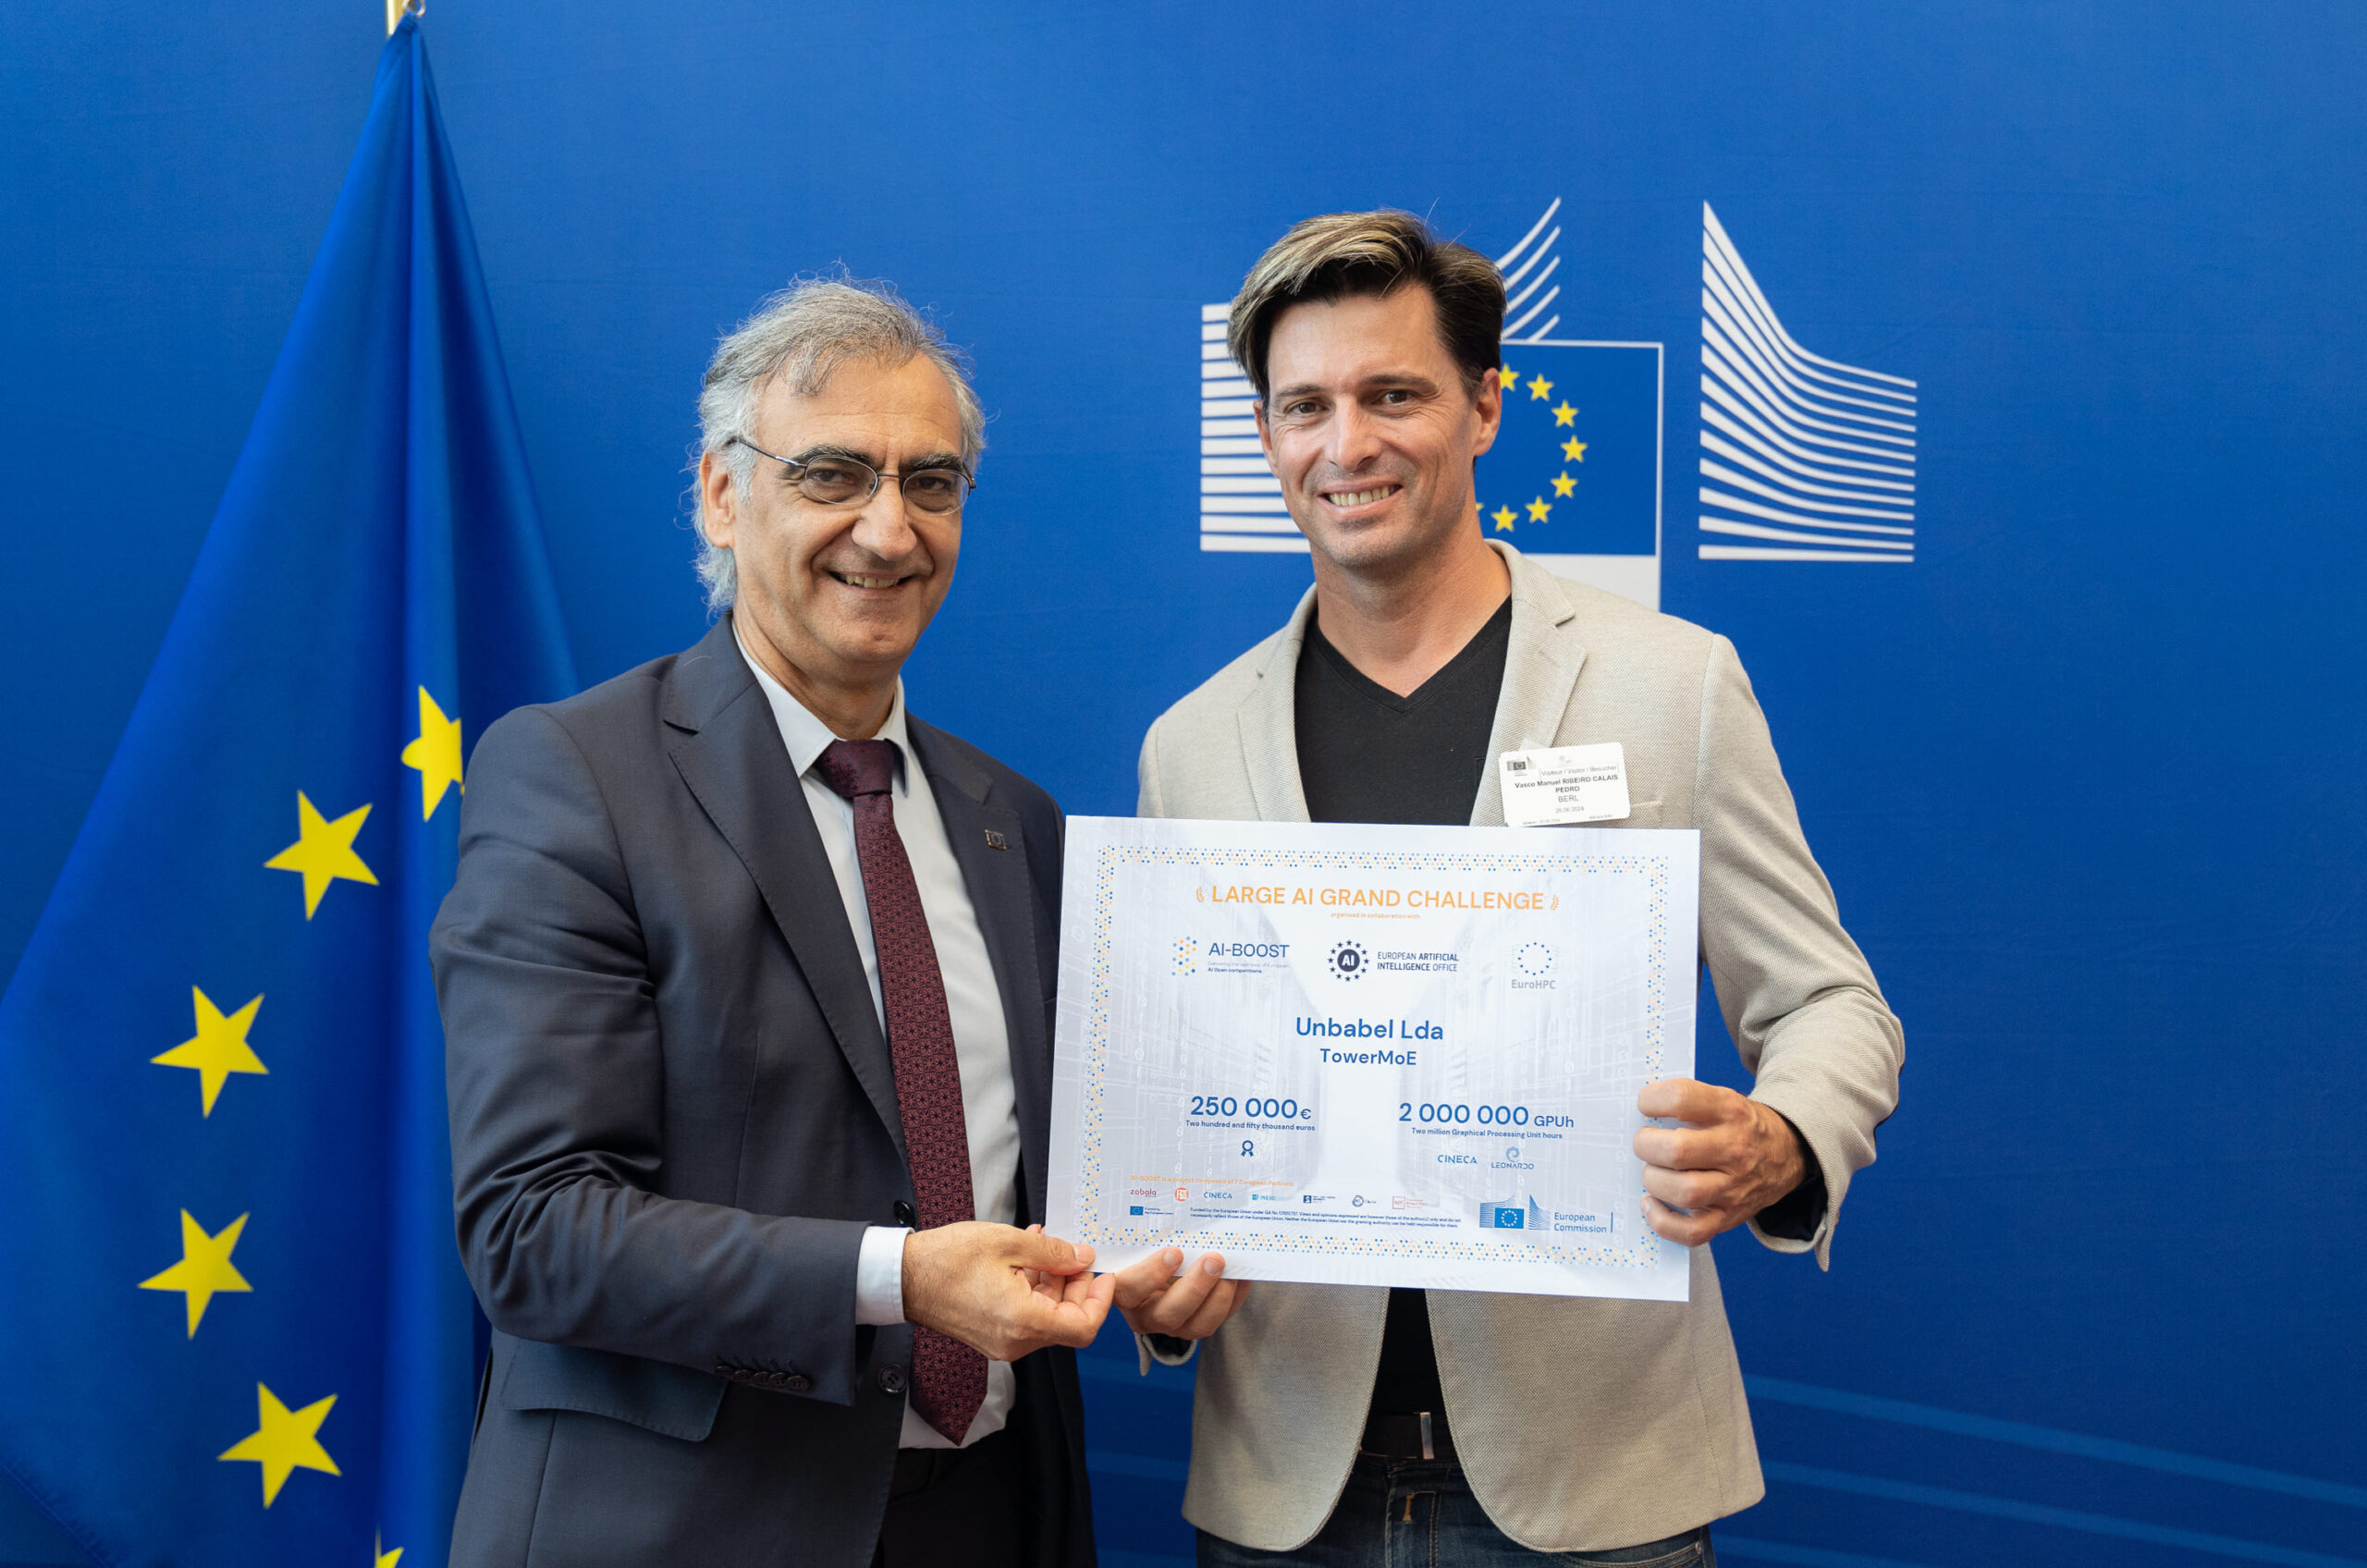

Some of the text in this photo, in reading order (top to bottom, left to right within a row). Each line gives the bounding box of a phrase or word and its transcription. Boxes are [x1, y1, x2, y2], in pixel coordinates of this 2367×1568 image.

[1592, 774, 1619, 782] CALAIS
[1212, 886, 1544, 910] LARGE AI GRAND CHALLENGE
[1208, 942, 1290, 958] AI-BOOST
[1342, 954, 1355, 966] AI
[1378, 951, 1459, 962] EUROPEAN ARTIFICIAL
[1377, 962, 1458, 972] INTELLIGENCE OFFICE
[1511, 979, 1556, 990] EuroHPC
[1296, 1017, 1443, 1040] Unbabel Lda
[1319, 1047, 1417, 1066] TowerMoE
[1191, 1096, 1238, 1117] 250
[1399, 1102, 1575, 1128] 2 000 000 GPUh
[1246, 1121, 1261, 1131] fifty
[1262, 1122, 1294, 1131] thousand
[1452, 1129, 1486, 1137] Graphical
[1487, 1130, 1526, 1140] Processing
[1437, 1154, 1478, 1164] CINECA
[1131, 1187, 1157, 1195] zabala
[1554, 1211, 1596, 1222] European
[1553, 1223, 1607, 1233] Commission
